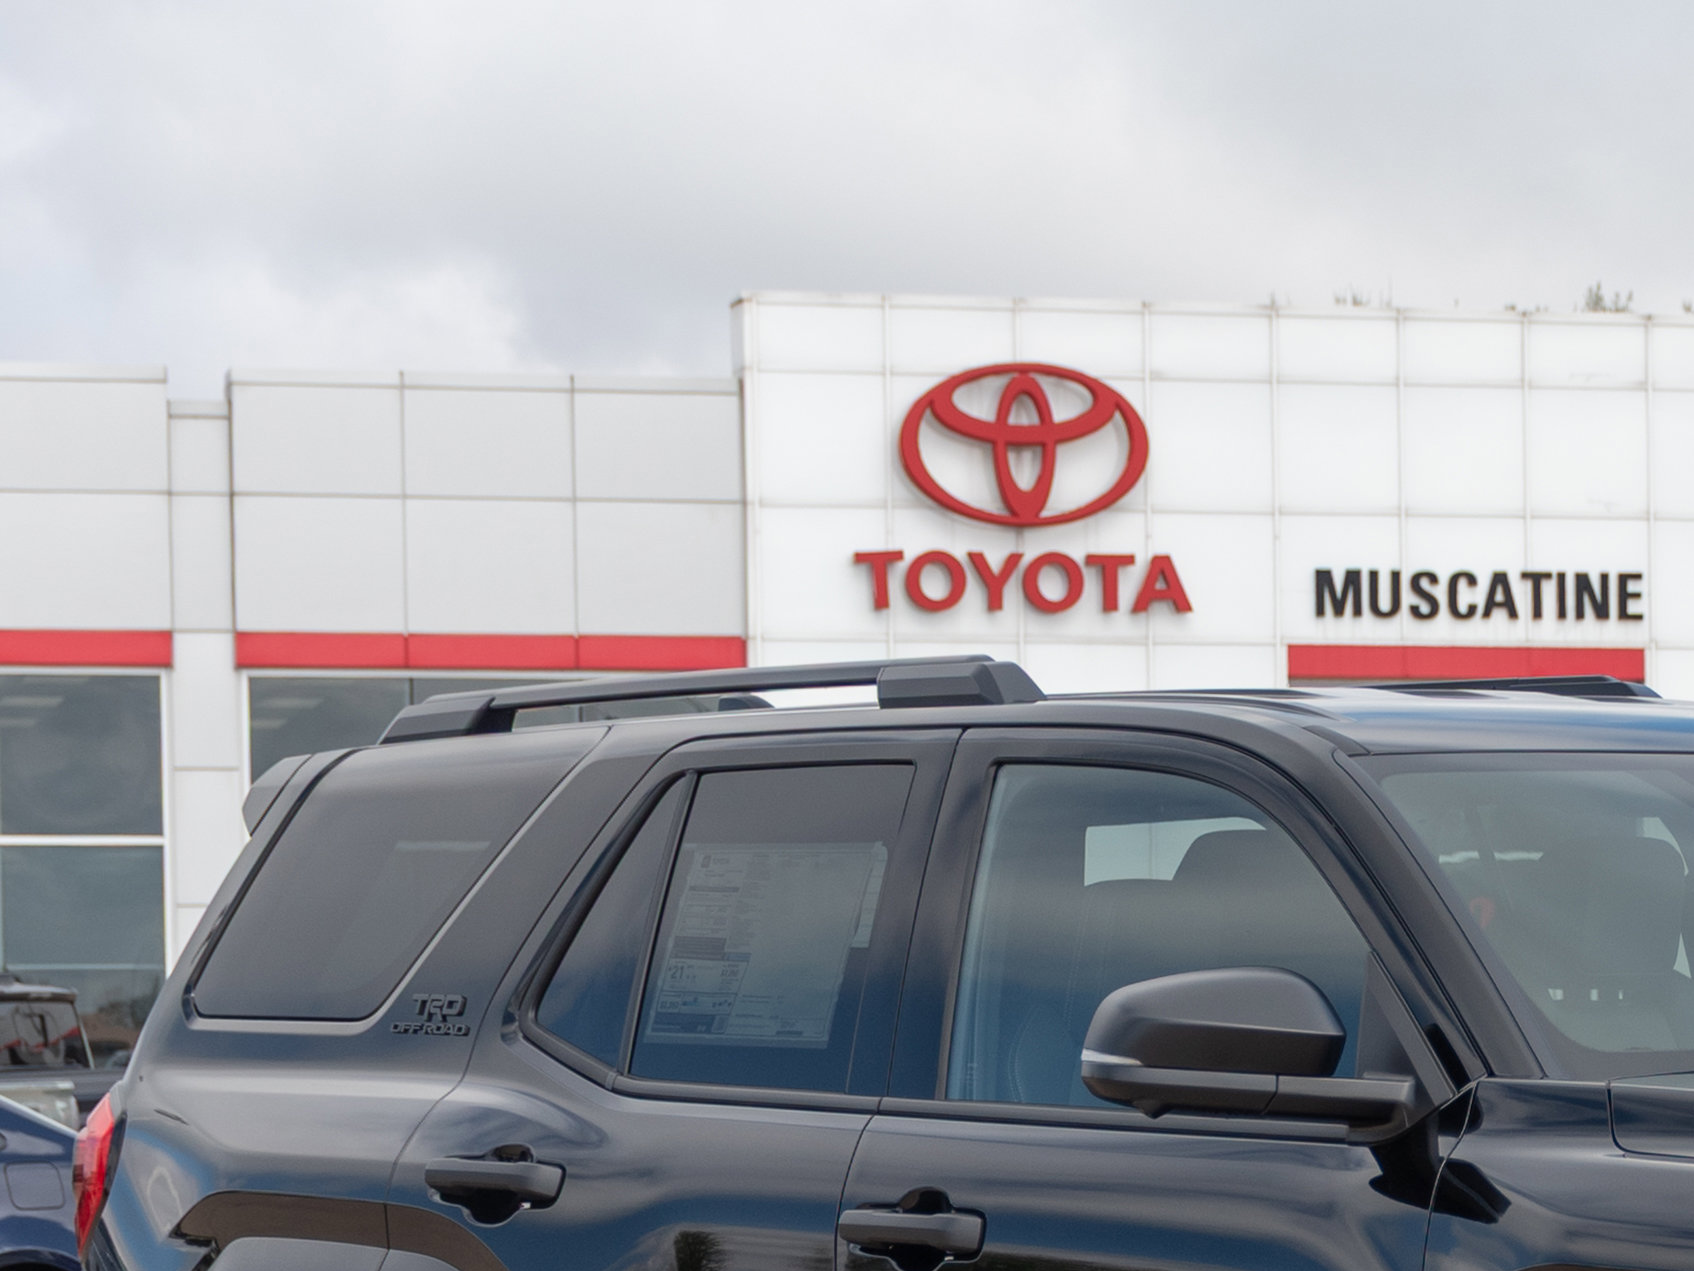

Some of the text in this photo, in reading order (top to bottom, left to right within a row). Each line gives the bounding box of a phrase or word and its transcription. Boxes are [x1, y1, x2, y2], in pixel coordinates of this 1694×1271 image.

[854, 549, 1193, 614] TOYOTA
[1314, 568, 1644, 622] MUSCATINE
[412, 993, 468, 1022] TRD
